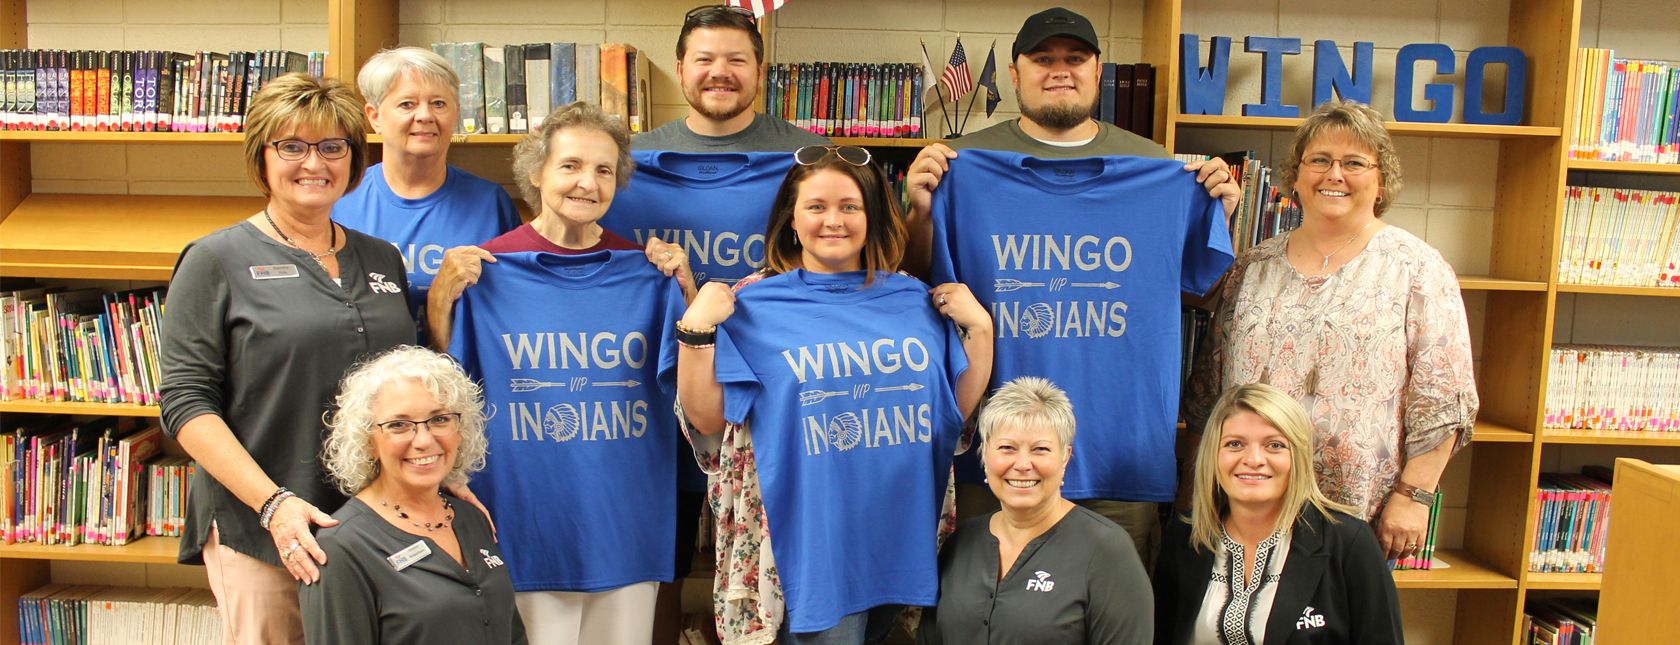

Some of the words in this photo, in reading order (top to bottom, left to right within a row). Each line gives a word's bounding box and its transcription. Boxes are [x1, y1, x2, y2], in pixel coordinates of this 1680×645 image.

[1179, 33, 1527, 125] WINGO
[991, 234, 1132, 272] WINGO
[369, 282, 401, 294] FNB
[1049, 277, 1068, 292] VIP
[501, 331, 648, 370] WINGO
[781, 337, 929, 384] WINGO
[570, 376, 588, 393] VIP
[853, 384, 871, 400] VIP
[1026, 579, 1055, 592] FNB
[1296, 613, 1327, 630] FNB
